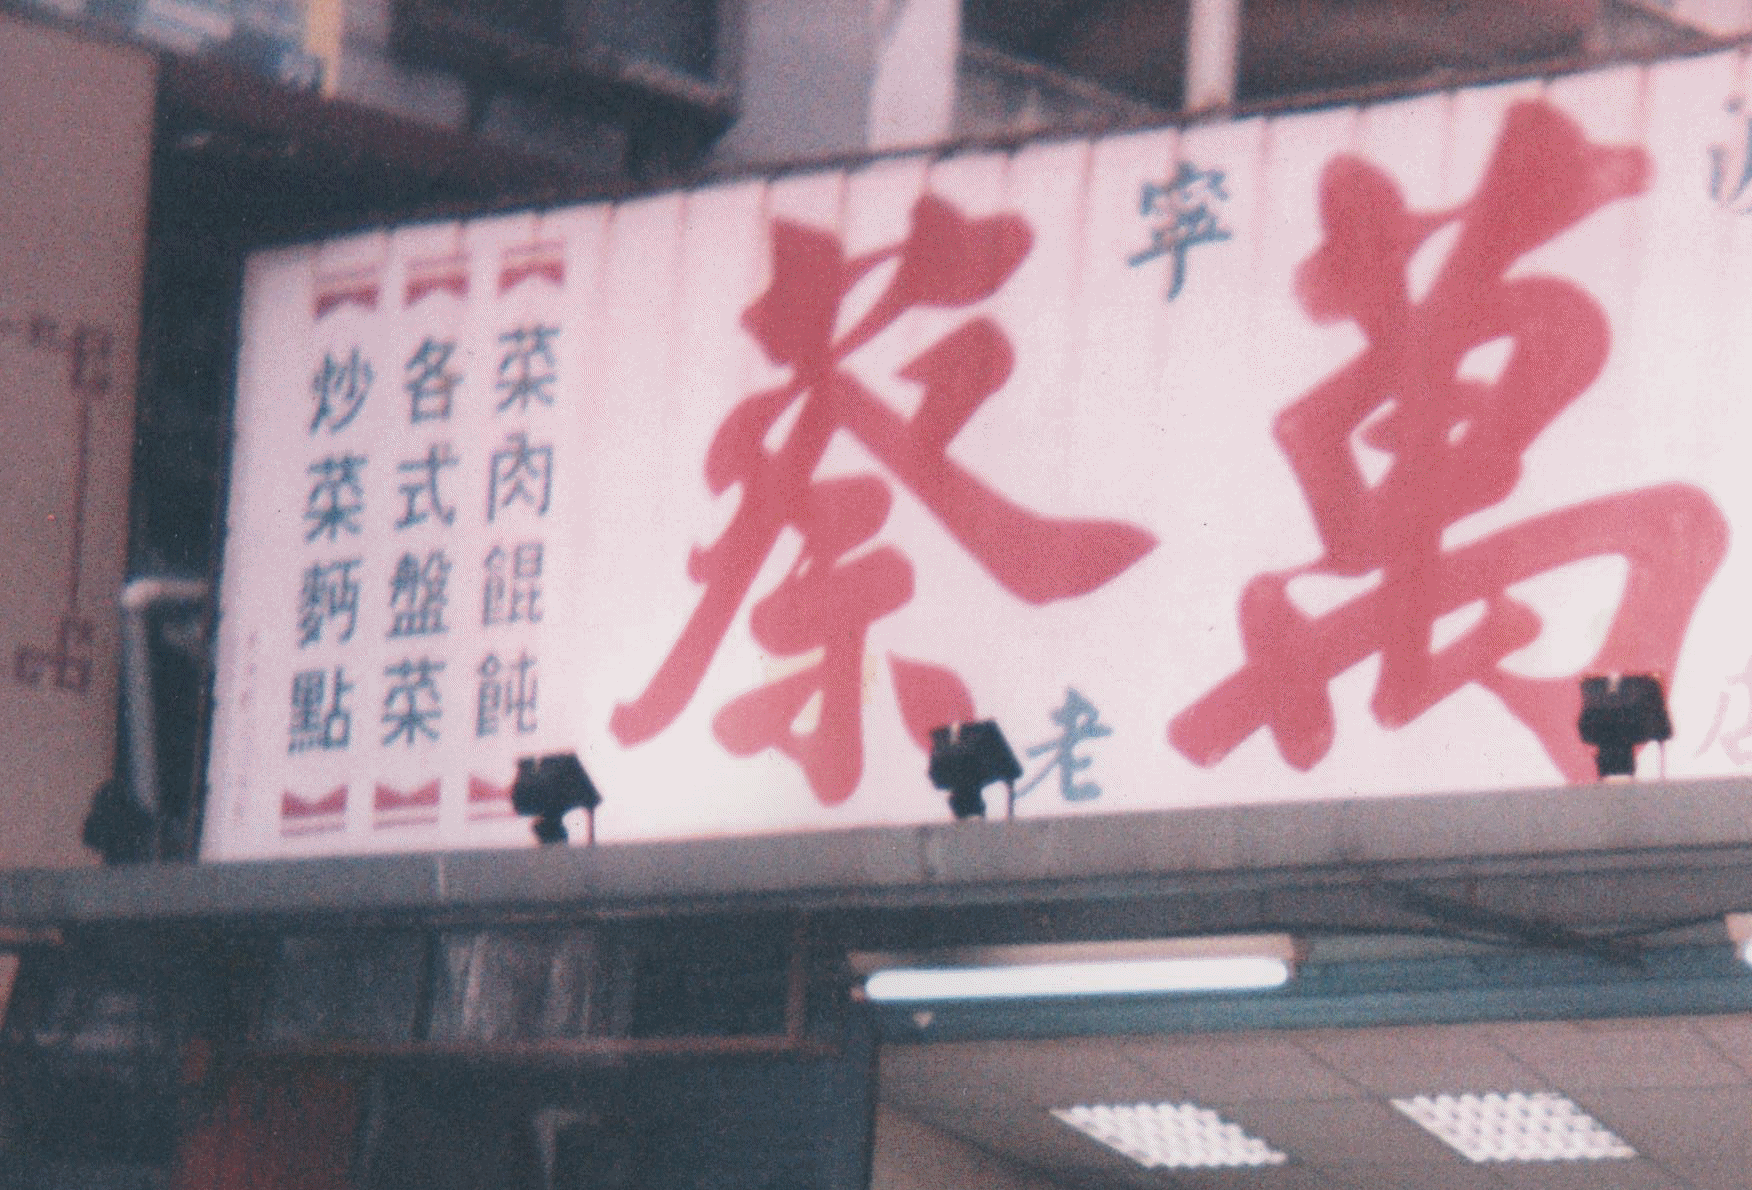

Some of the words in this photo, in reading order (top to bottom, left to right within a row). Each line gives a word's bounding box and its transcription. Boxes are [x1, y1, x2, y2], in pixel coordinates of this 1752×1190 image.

[378, 334, 466, 748] 各式盤菜
[473, 322, 562, 741] 菜肉餛飩
